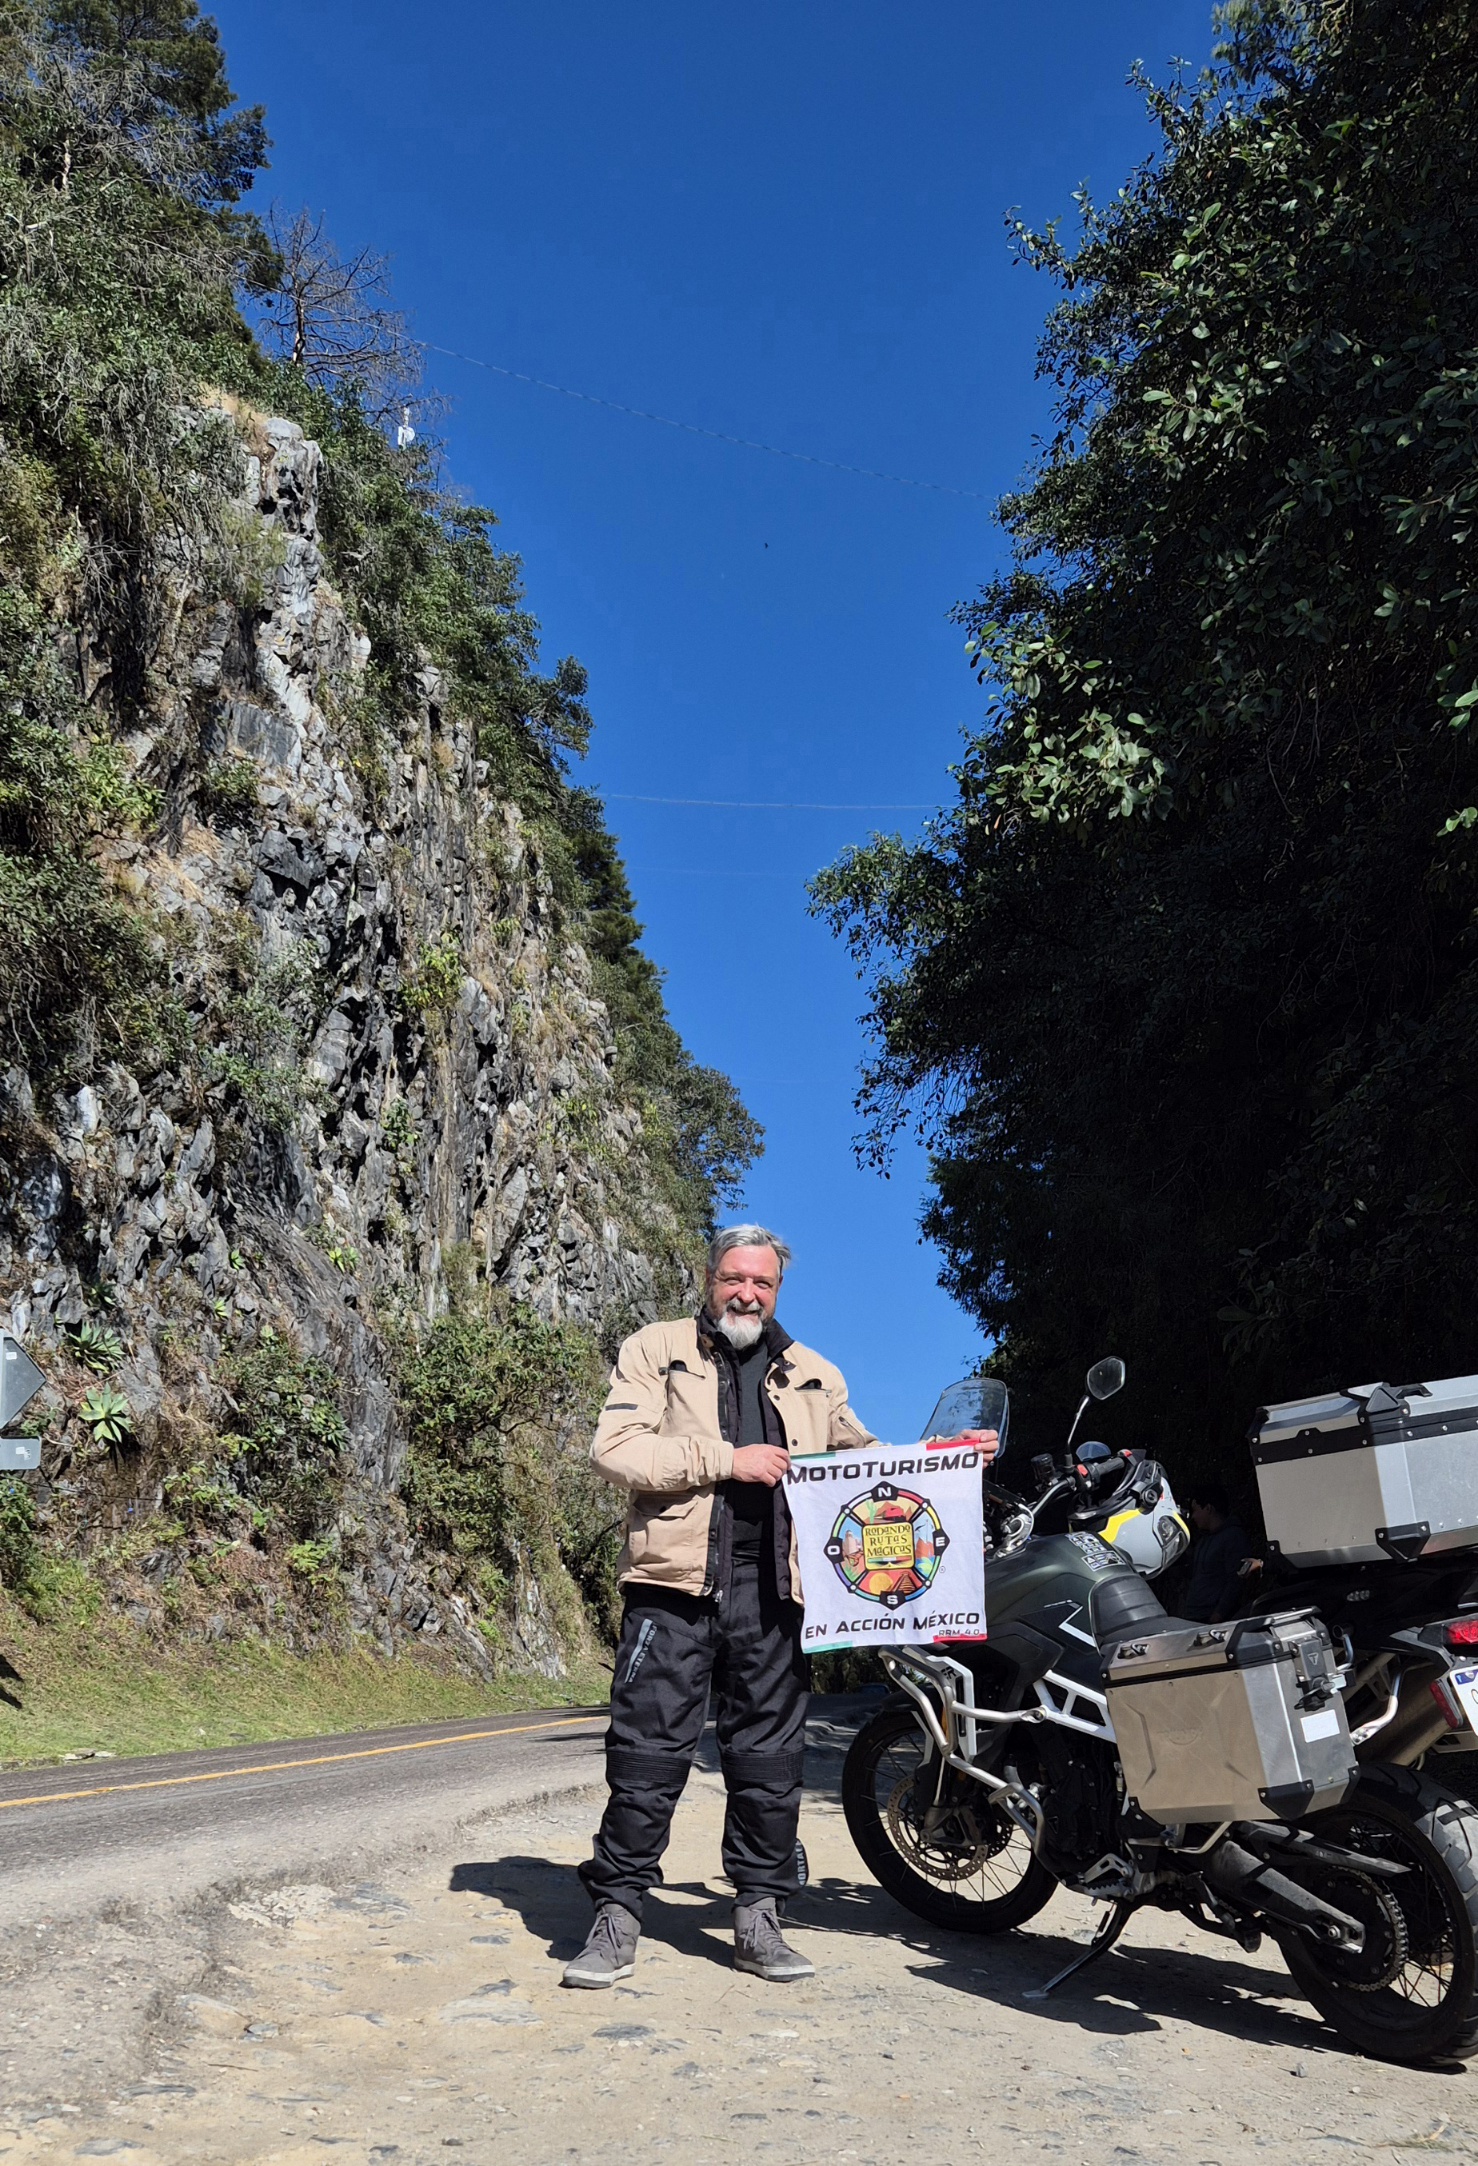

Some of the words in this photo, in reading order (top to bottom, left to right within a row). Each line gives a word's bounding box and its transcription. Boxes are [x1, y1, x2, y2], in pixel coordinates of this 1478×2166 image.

[786, 1452, 979, 1485] MOTOTURISMO
[877, 1486, 892, 1497] N
[935, 1535, 946, 1547] E
[827, 1545, 840, 1556] O
[886, 1594, 898, 1605] S
[805, 1624, 827, 1640] EN
[835, 1613, 906, 1634] ACCIÓN
[913, 1610, 980, 1631] MÉXICO
